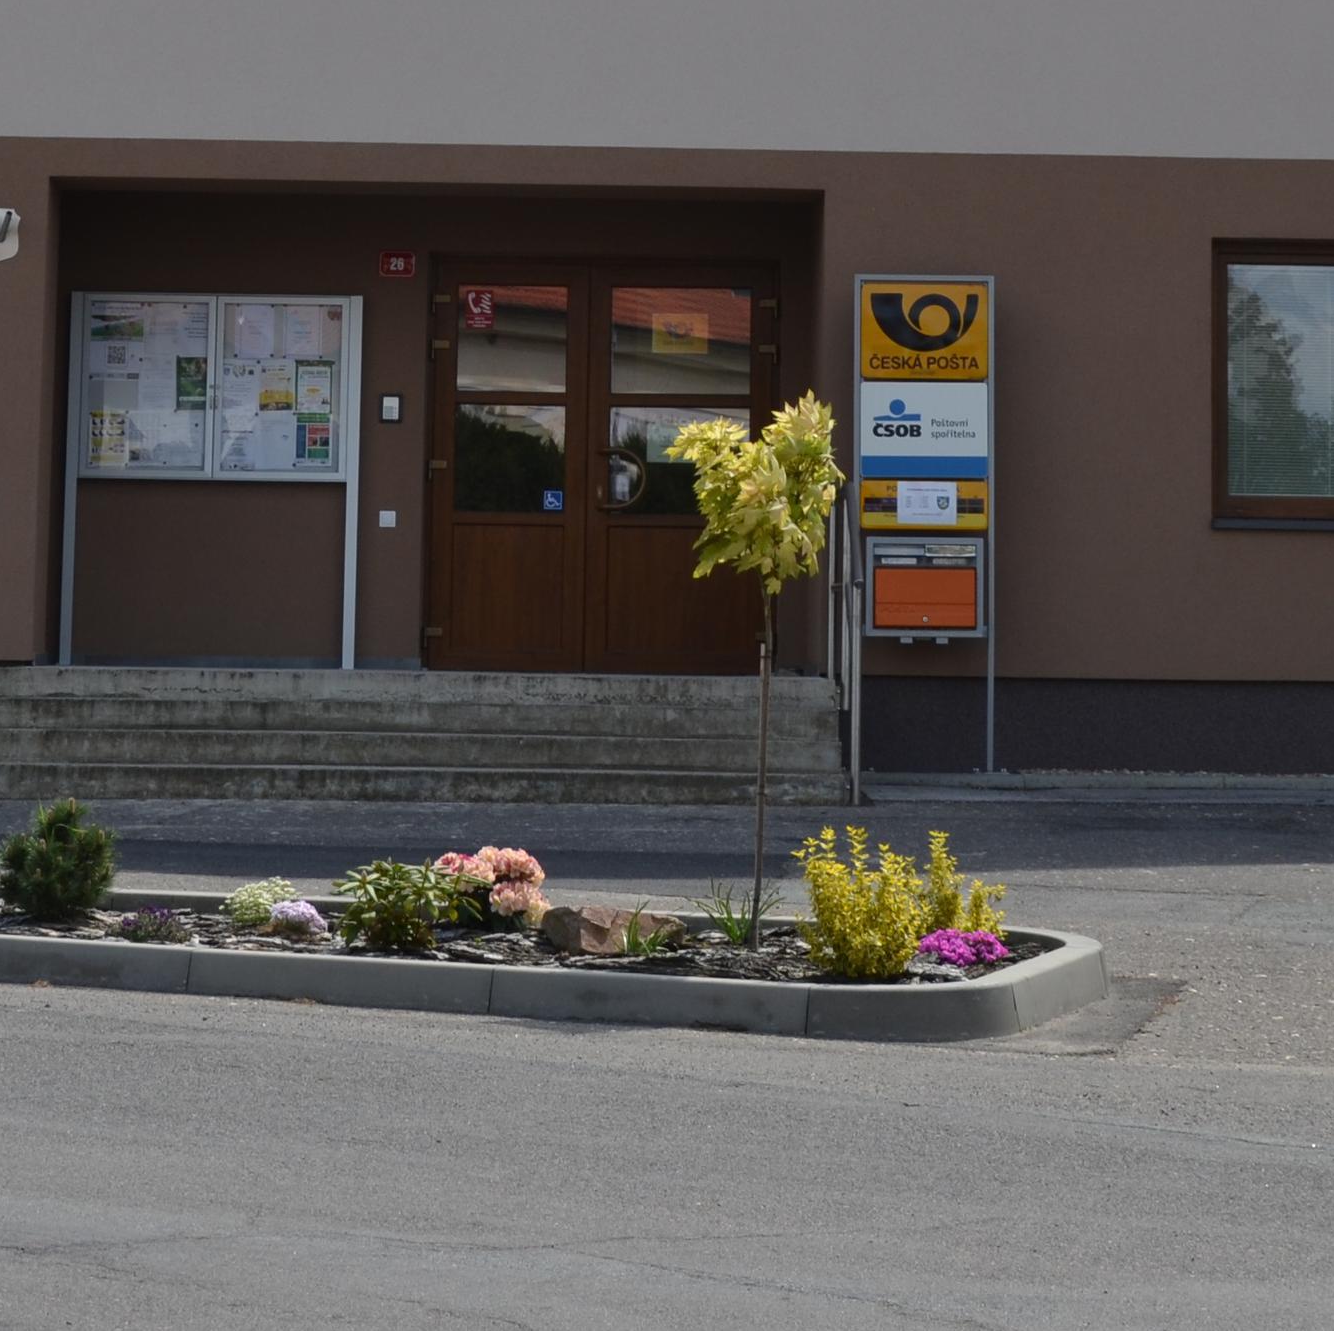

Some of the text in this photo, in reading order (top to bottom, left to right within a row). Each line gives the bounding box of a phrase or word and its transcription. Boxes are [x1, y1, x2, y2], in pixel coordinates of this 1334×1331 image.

[390, 256, 404, 271] 26
[869, 353, 980, 370] ČESKÁ POŠTA
[872, 422, 922, 438] ČSOB
[931, 418, 969, 428] Poštovní
[931, 430, 976, 440] spořitelna
